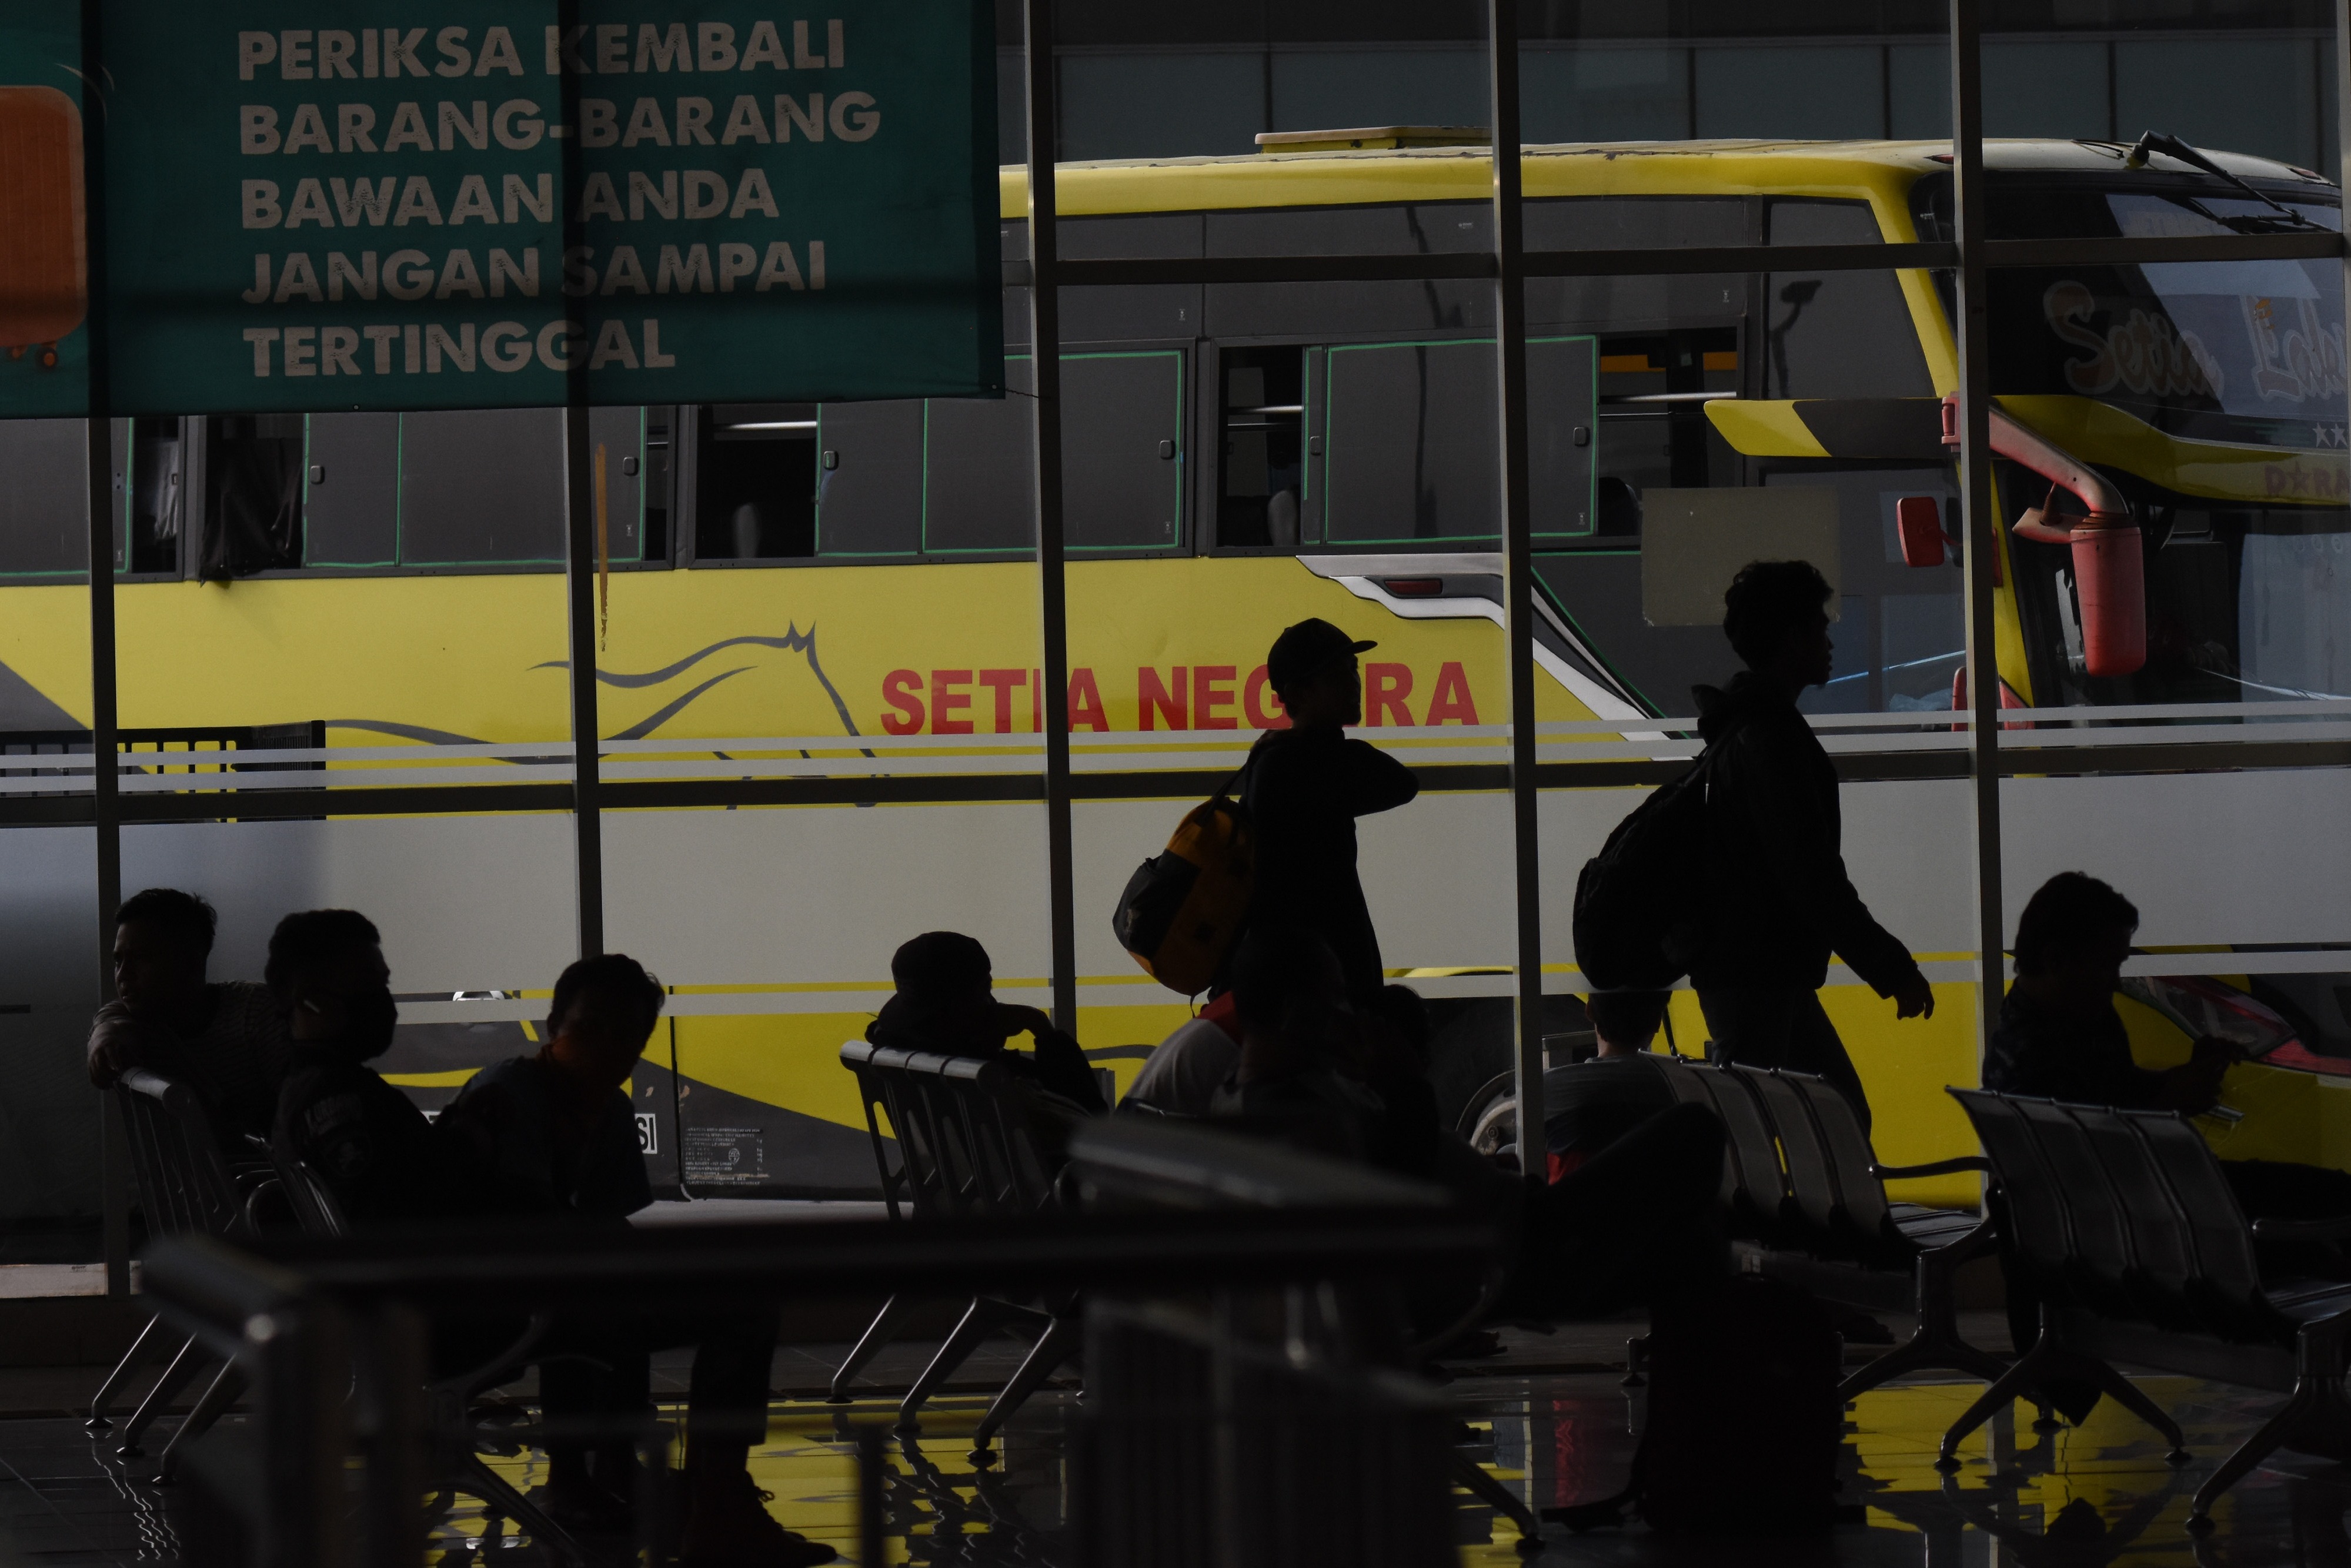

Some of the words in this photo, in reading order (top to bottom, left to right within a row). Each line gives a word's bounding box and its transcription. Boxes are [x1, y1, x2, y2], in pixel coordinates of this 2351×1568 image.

[239, 25, 524, 81] PERIKSA
[545, 18, 844, 76] KEMBALI
[240, 91, 881, 155] BARANG-BARANG
[241, 173, 553, 229] BAWAAN
[575, 168, 780, 223] ANDA
[242, 248, 540, 305] JANGAN
[562, 240, 825, 298] SAMPAI
[242, 319, 676, 378] TERTINGGAL
[2042, 280, 2225, 400] Setia
[880, 667, 1110, 735] SETIA
[1138, 661, 1480, 731] NEGRA
